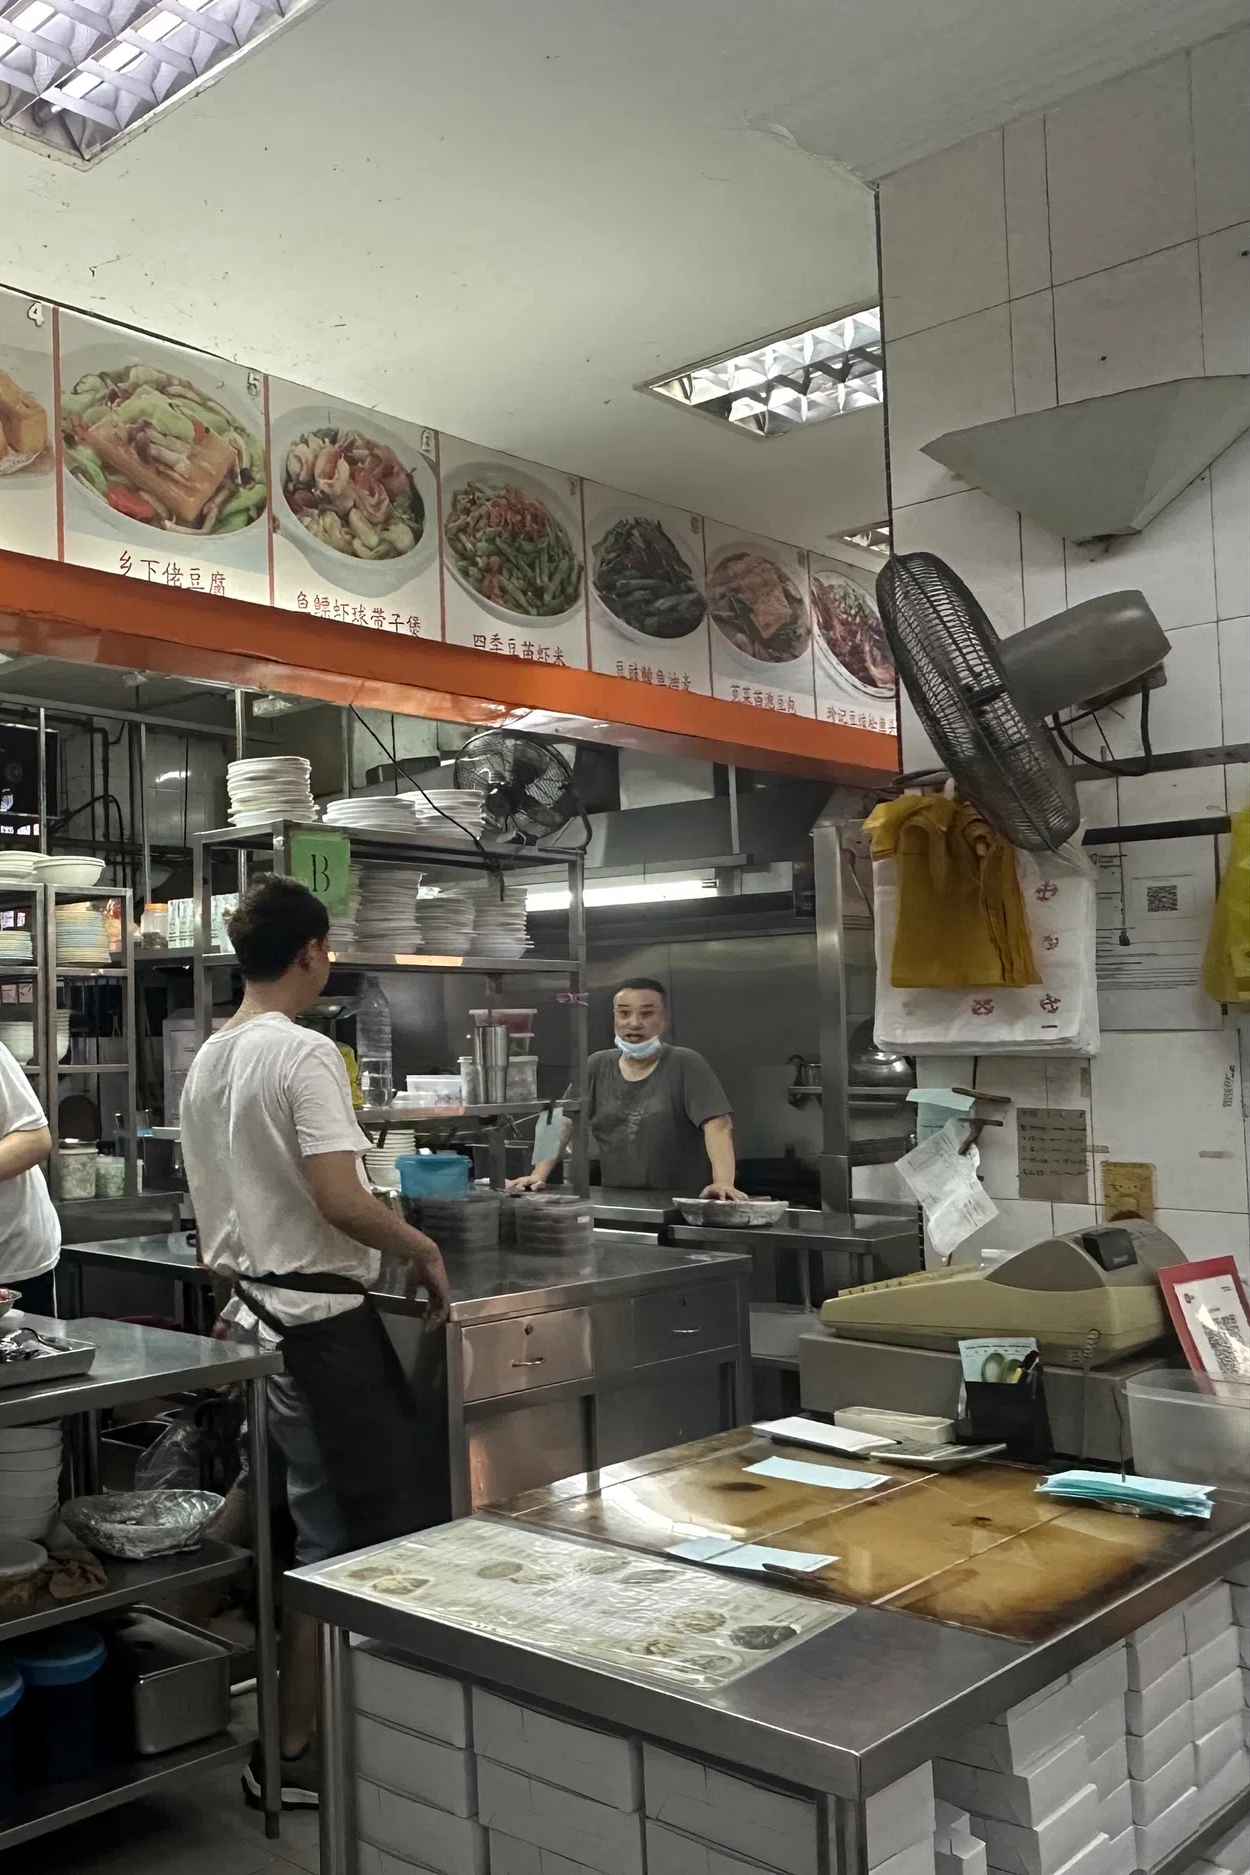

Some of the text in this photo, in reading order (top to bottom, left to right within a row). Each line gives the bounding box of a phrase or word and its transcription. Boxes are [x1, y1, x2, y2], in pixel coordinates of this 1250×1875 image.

[27, 301, 44, 327] 4
[247, 372, 260, 397] 5
[119, 550, 226, 596] 乡下佬豆腐
[310, 853, 331, 893] B
